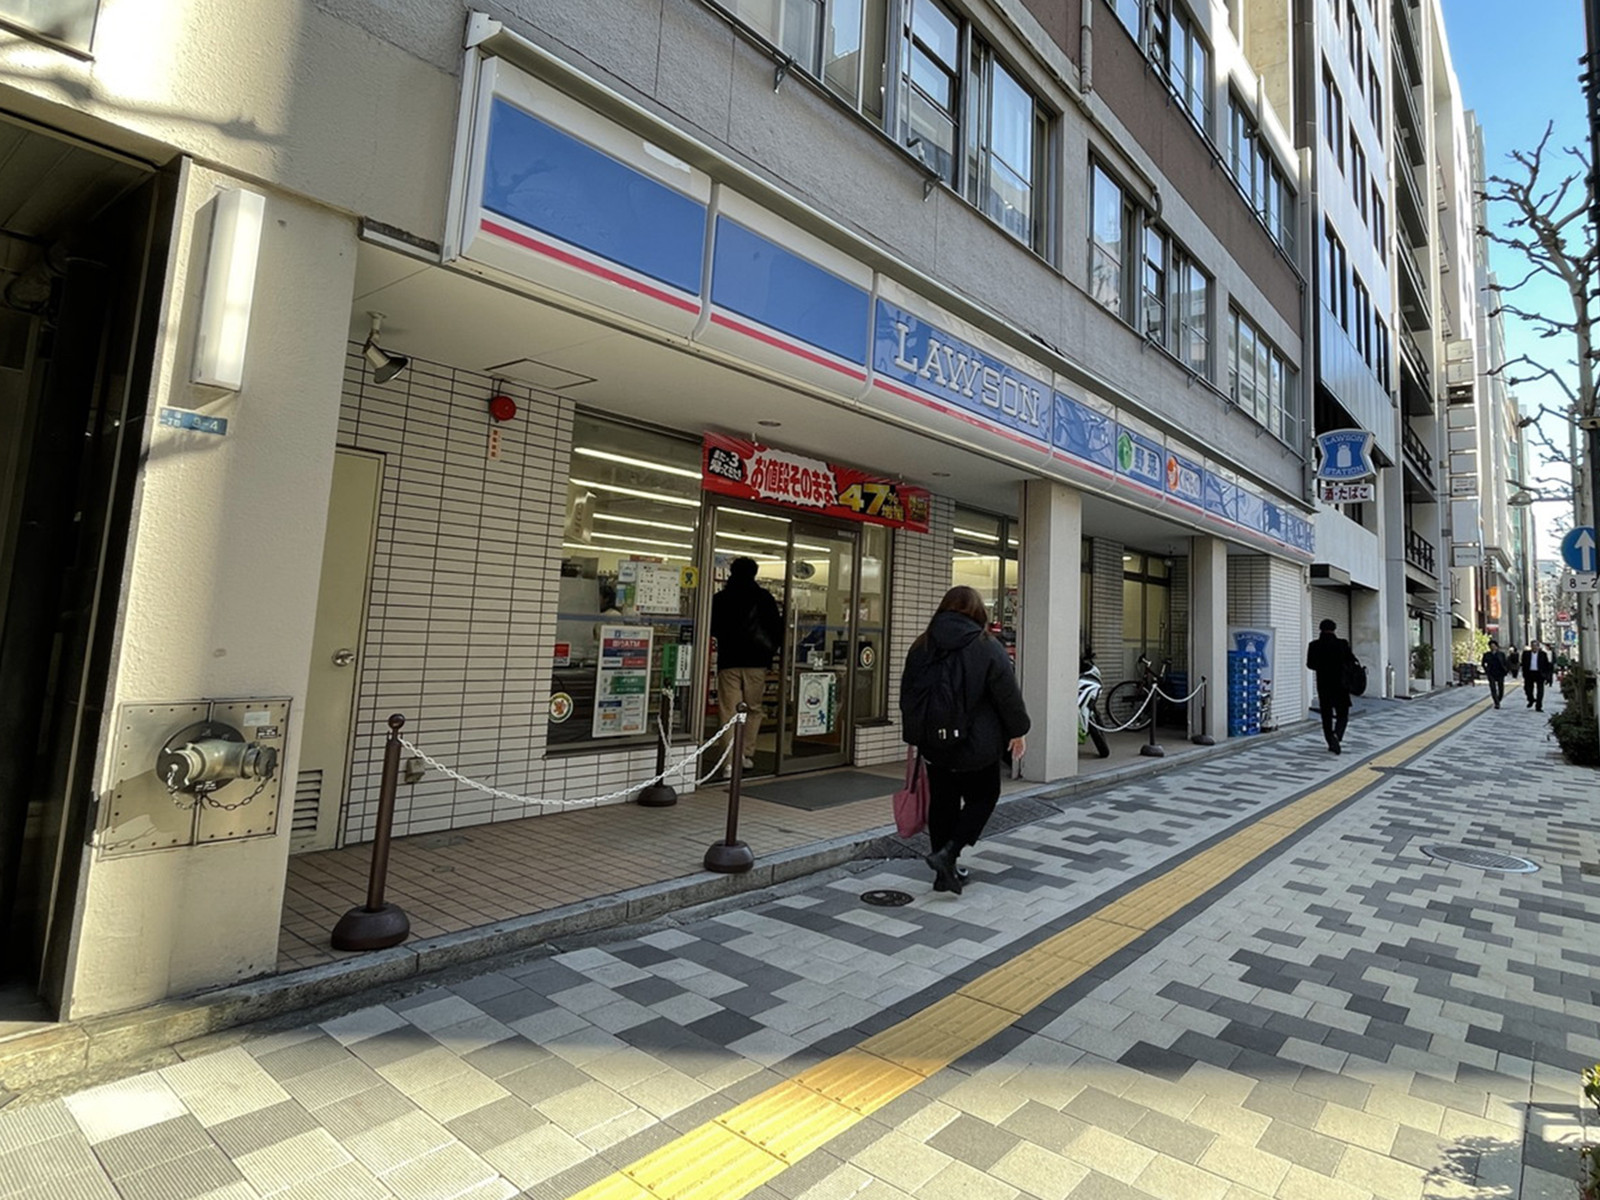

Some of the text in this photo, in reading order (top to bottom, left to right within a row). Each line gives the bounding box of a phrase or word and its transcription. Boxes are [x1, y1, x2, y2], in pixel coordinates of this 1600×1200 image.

[894, 322, 1040, 427] LAWSON
[1324, 434, 1365, 445] LAWSON
[751, 455, 834, 504] お値段そのまま
[1324, 465, 1365, 476] STATION
